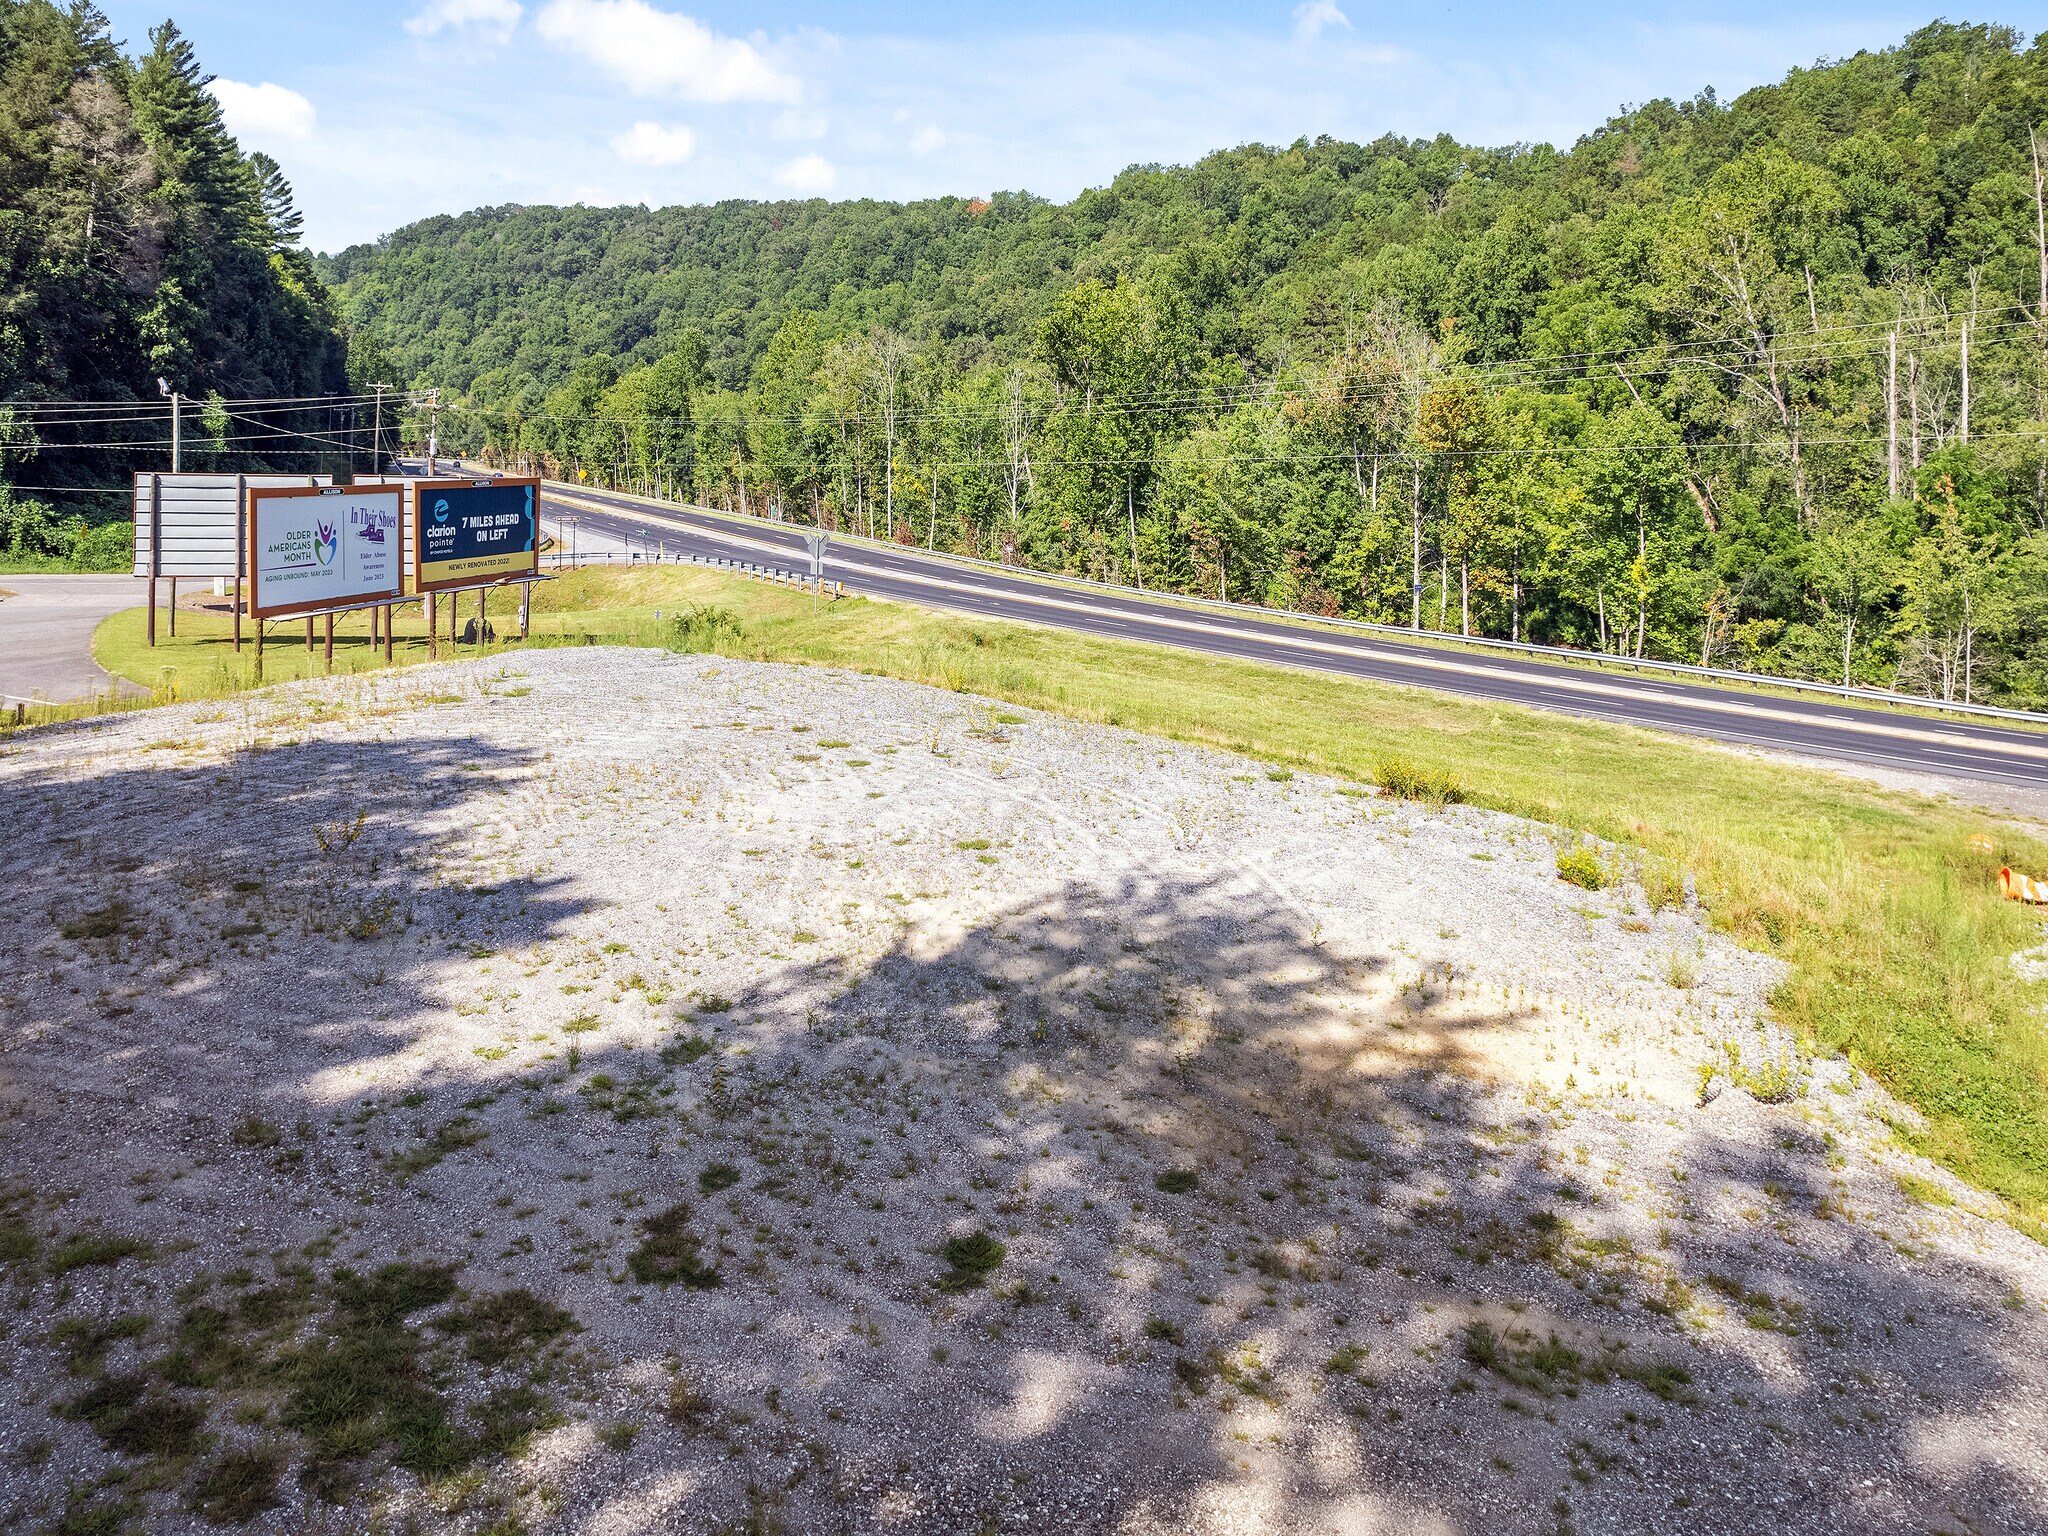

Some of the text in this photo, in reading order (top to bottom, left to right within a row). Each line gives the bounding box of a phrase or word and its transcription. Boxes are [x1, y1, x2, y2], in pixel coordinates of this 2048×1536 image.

[350, 506, 396, 528] In Their Shoes
[462, 513, 520, 529] 7 MILES AHEAD
[286, 530, 312, 541] OLDER
[427, 524, 456, 538] clarion
[476, 528, 509, 543] ON LEFT
[268, 541, 312, 553] AMERICANS
[429, 539, 455, 549] pointe
[284, 552, 312, 562] MONTH
[448, 557, 511, 571] NEWLY RENOVATED 2022!
[264, 574, 283, 582] AGING
[283, 571, 309, 581] UNBOUND:
